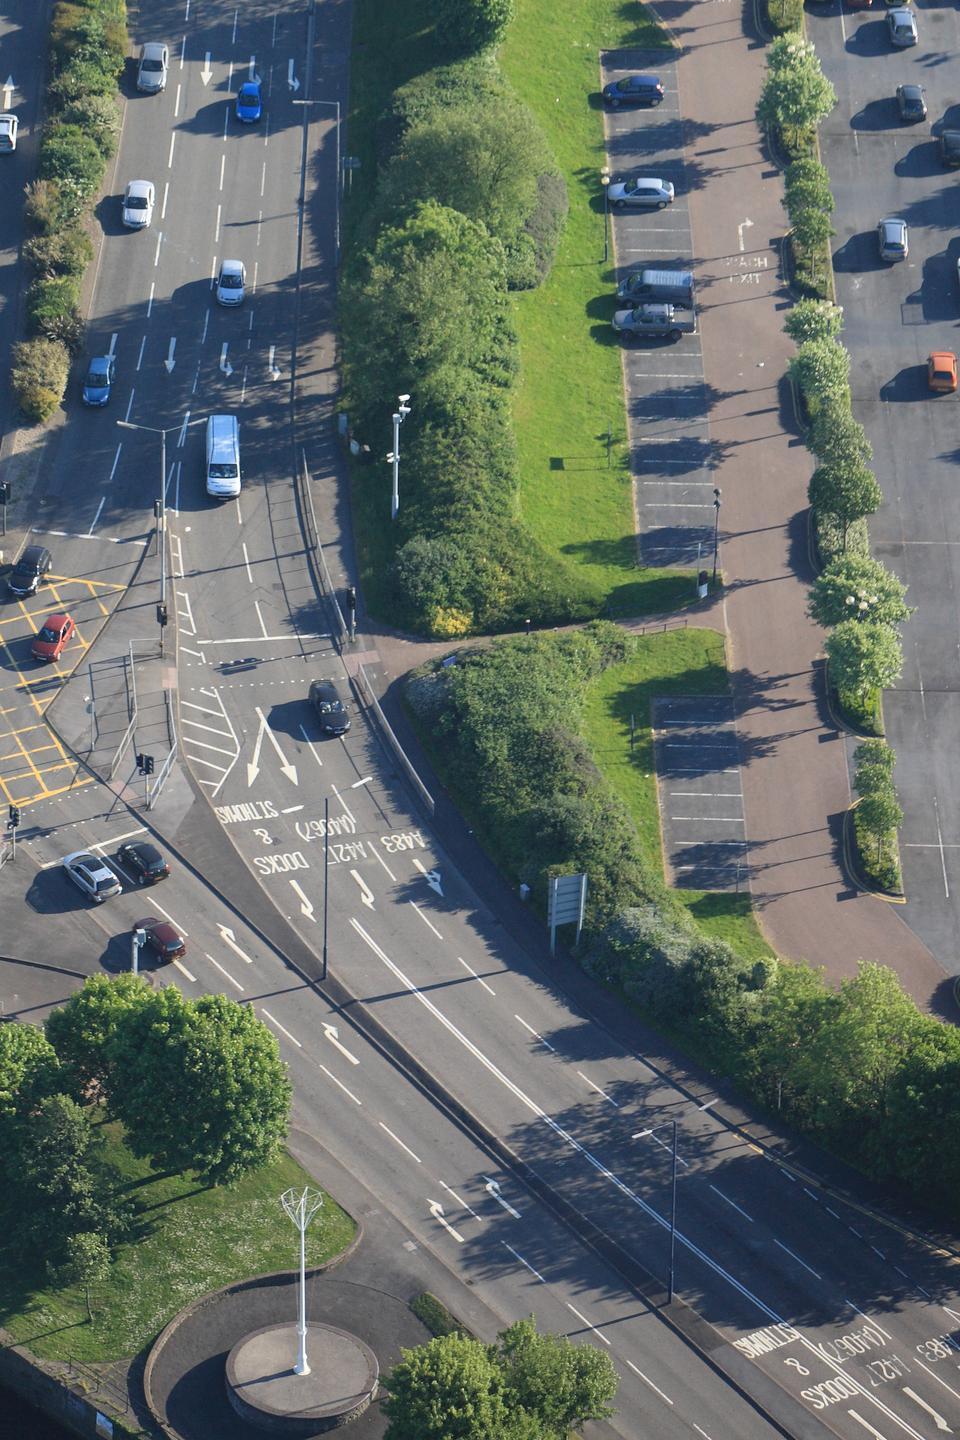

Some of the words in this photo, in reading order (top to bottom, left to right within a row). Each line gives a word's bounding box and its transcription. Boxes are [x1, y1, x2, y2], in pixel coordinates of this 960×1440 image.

[726, 257, 768, 268] ACH
[253, 827, 274, 845] &
[380, 830, 427, 853] A483
[253, 851, 310, 875] DOCKS
[916, 1333, 960, 1362] A483
[784, 1357, 810, 1376] &
[800, 1376, 861, 1409] DOCKS
